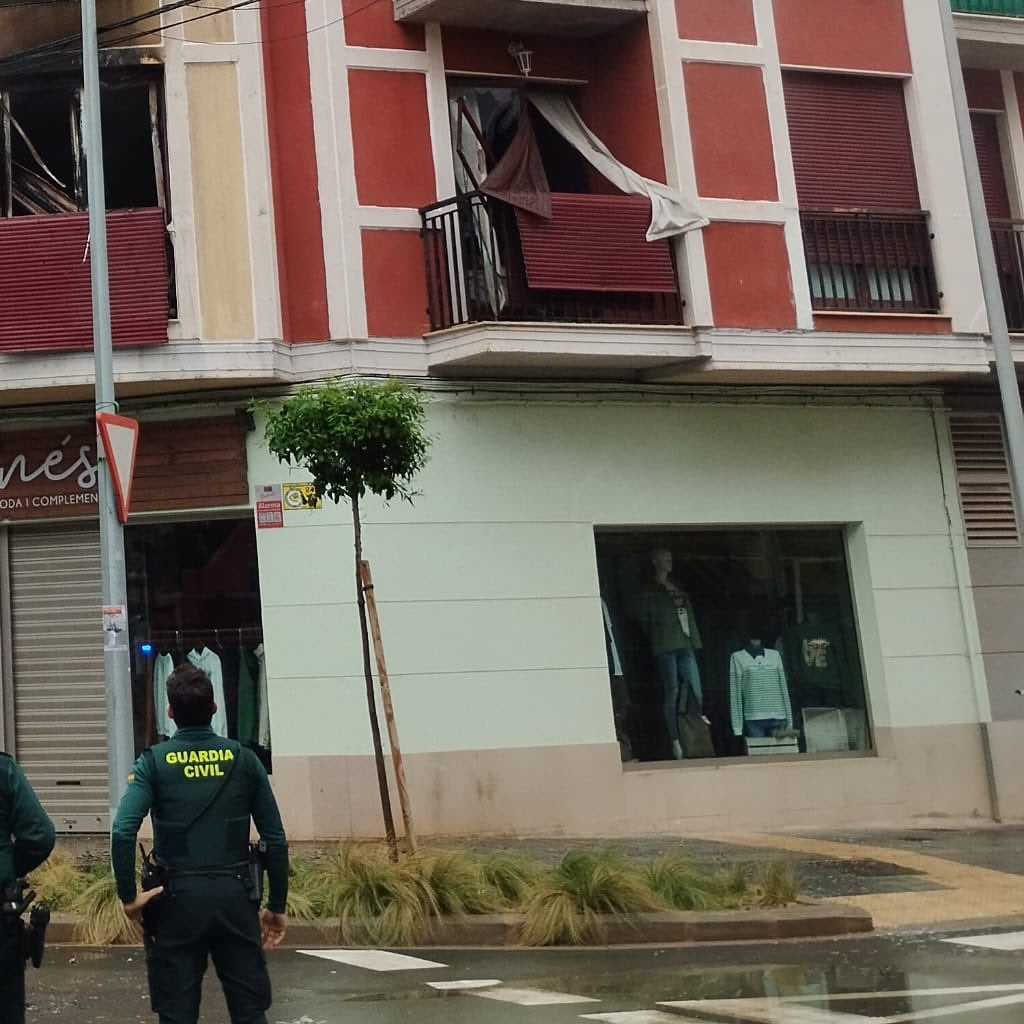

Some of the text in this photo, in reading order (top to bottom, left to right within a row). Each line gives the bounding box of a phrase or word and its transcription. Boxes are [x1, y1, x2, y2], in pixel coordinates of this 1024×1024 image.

[32, 493, 99, 507] COMPLEMEN
[166, 749, 234, 764] GUARDIA
[184, 764, 224, 778] CIVIL
